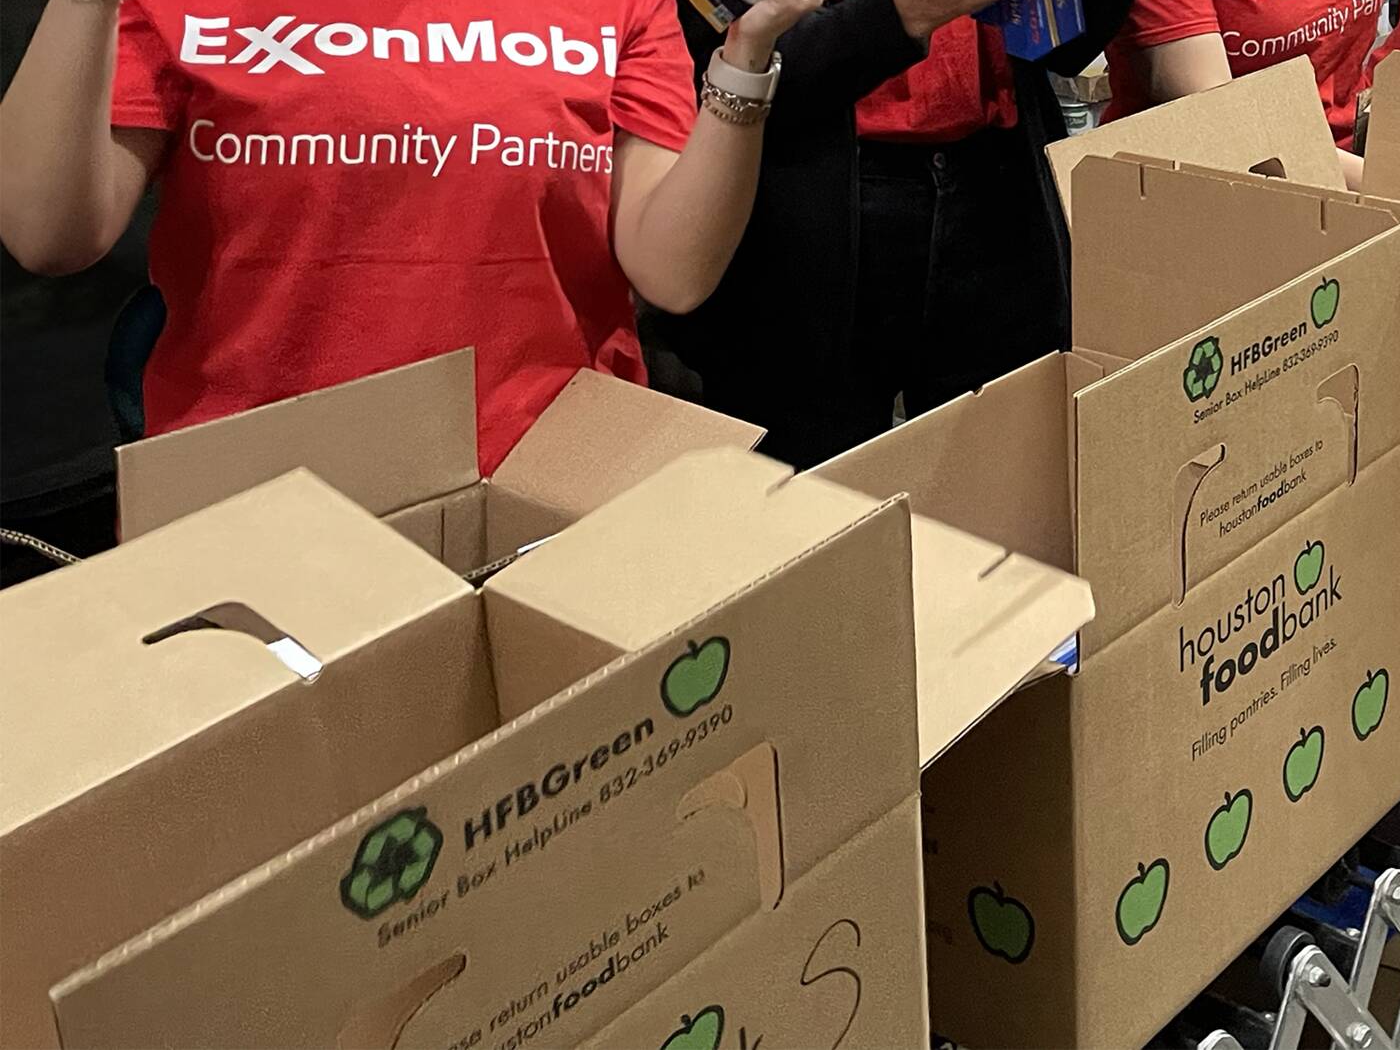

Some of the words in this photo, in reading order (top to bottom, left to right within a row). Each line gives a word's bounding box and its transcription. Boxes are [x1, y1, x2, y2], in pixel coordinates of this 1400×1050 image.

[180, 14, 617, 76] ExxonMobi
[1222, 7, 1349, 58] Community
[190, 120, 457, 178] Community
[471, 123, 613, 174] Partners
[1193, 399, 1224, 424] Senior
[1225, 387, 1243, 407] Box
[1244, 366, 1281, 397] HelpLine
[1282, 329, 1339, 374] 832-369-9390
[1230, 321, 1307, 376] HFBGreen
[1200, 501, 1230, 527] Please
[1232, 481, 1258, 504] return
[1260, 461, 1288, 487] usable
[1289, 449, 1314, 470] boxes
[1315, 440, 1324, 451] to
[1219, 468, 1307, 538] houstonfoodbank
[1180, 573, 1285, 672] houston
[1200, 565, 1343, 707] foodbank
[1192, 725, 1227, 762] Filling
[1230, 687, 1279, 738] pantries.
[1280, 656, 1311, 691] Filling
[1313, 638, 1337, 665] lives.
[377, 889, 450, 948] Senior
[457, 861, 496, 898] Box
[505, 801, 593, 866] HelpLine
[600, 704, 733, 805] 832-369-9390
[463, 717, 655, 851] HFBGreen
[489, 981, 549, 1033] return
[556, 930, 621, 986] usable
[626, 883, 681, 937] boxes
[688, 868, 705, 891] to
